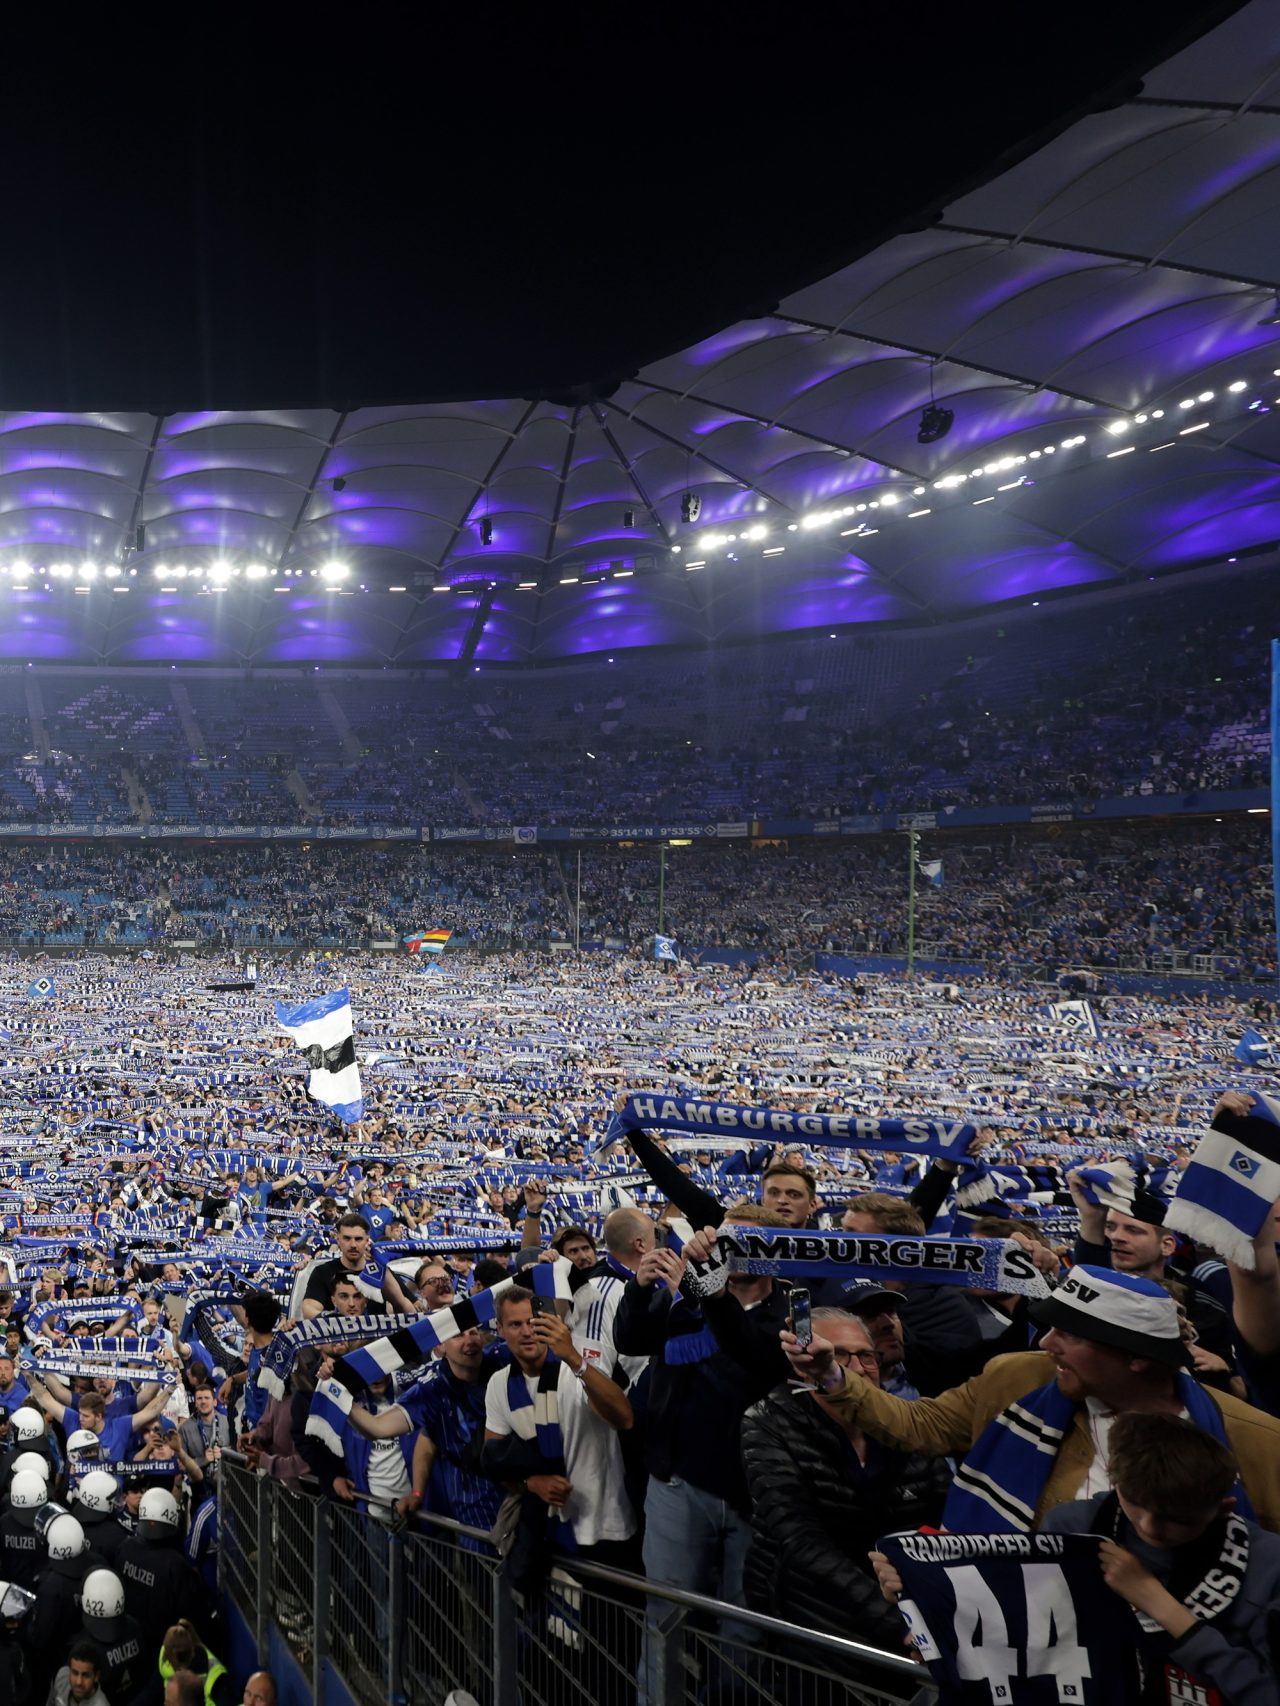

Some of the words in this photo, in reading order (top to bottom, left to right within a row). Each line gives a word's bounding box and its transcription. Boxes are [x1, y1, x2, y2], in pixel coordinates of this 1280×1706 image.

[634, 1098, 883, 1140] HAMBURGER
[903, 1121, 965, 1148] SV
[24, 1215, 78, 1224] HAMBURGER
[453, 1210, 472, 1219] SELKE
[414, 1237, 477, 1250] HAMBURG
[694, 1233, 986, 1277] HAMBURGER
[1003, 1248, 1036, 1280] S
[1062, 1278, 1102, 1304] SV
[34, 1296, 118, 1317] HAMBURGER
[121, 1295, 138, 1309] SV
[37, 1360, 75, 1372] TEAM
[79, 1363, 158, 1380] NORDHEIDE
[20, 1428, 37, 1437] A22
[74, 1459, 113, 1474] Helvetic
[116, 1460, 175, 1474] Supporters
[81, 1491, 100, 1506] A22
[4, 1535, 36, 1549] POLIZEI
[899, 1533, 1031, 1563] HAMBURGER
[53, 1546, 73, 1557] A22
[123, 1560, 155, 1588] POLIZEI
[85, 1600, 105, 1612] A22
[943, 1563, 1093, 1706] 44
[106, 1639, 139, 1668] POLIZEI
